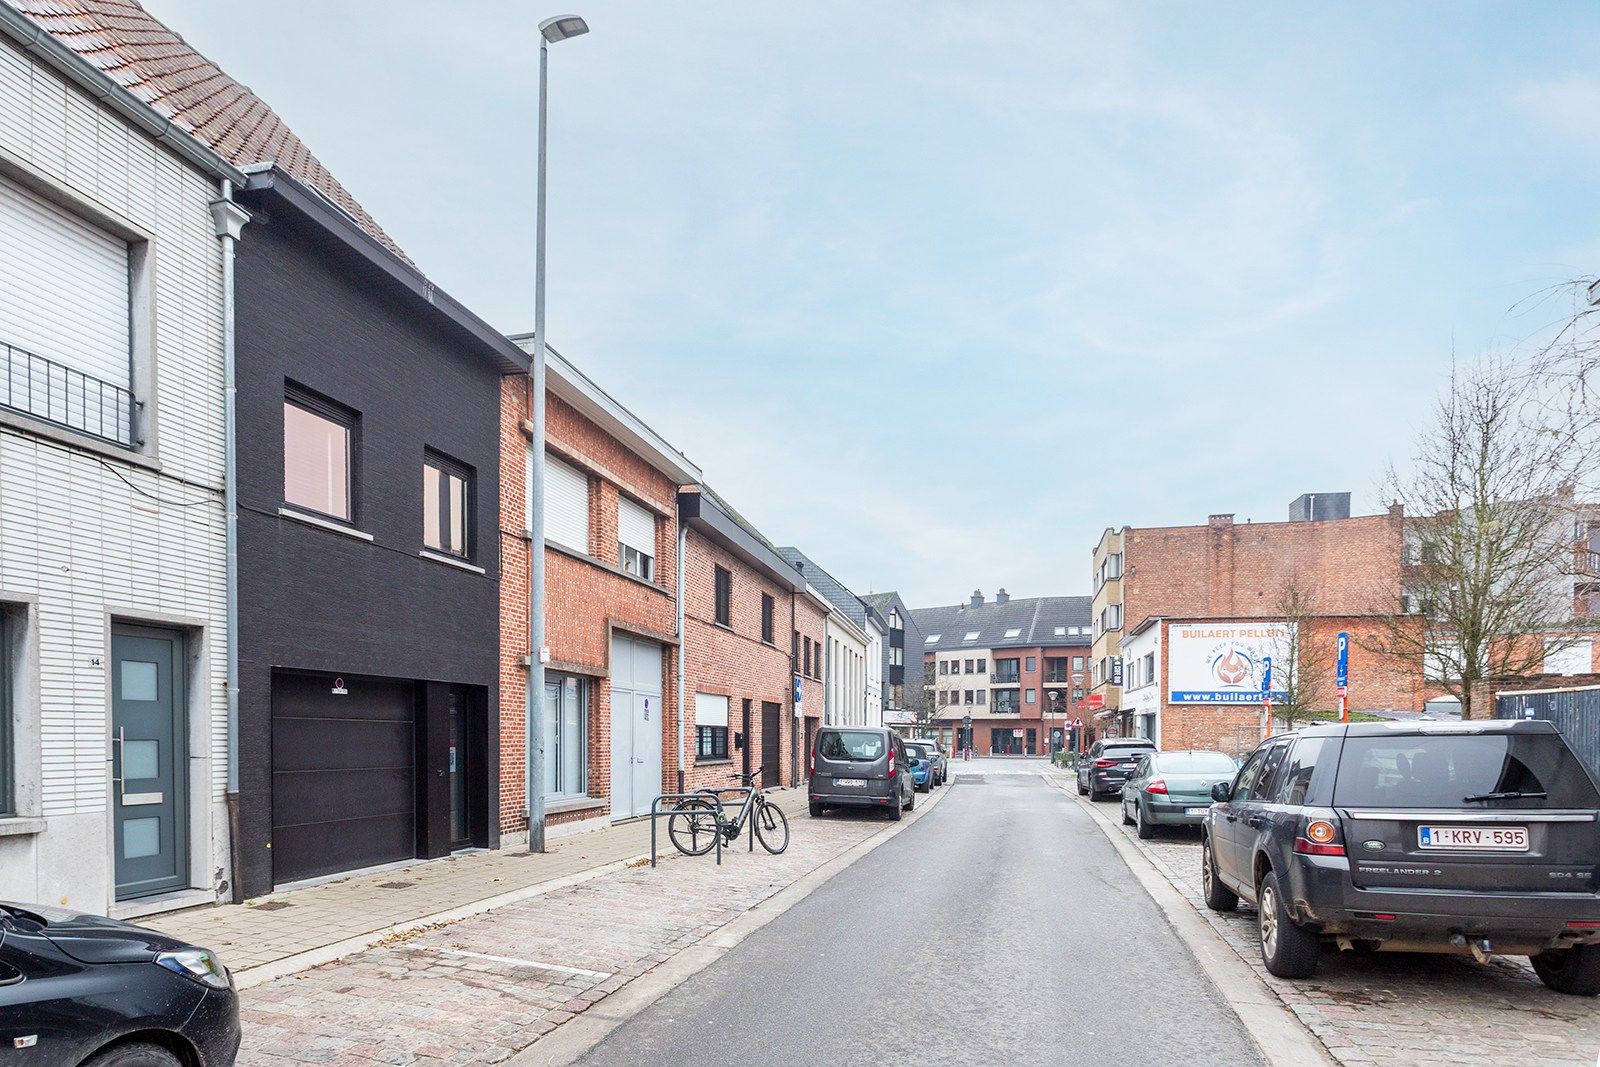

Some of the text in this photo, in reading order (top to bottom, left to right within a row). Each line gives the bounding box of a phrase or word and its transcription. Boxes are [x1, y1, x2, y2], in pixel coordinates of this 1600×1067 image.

[1182, 629, 1236, 638] BUILAERT
[1339, 637, 1346, 660] P
[1359, 867, 1430, 876] FREELANDER
